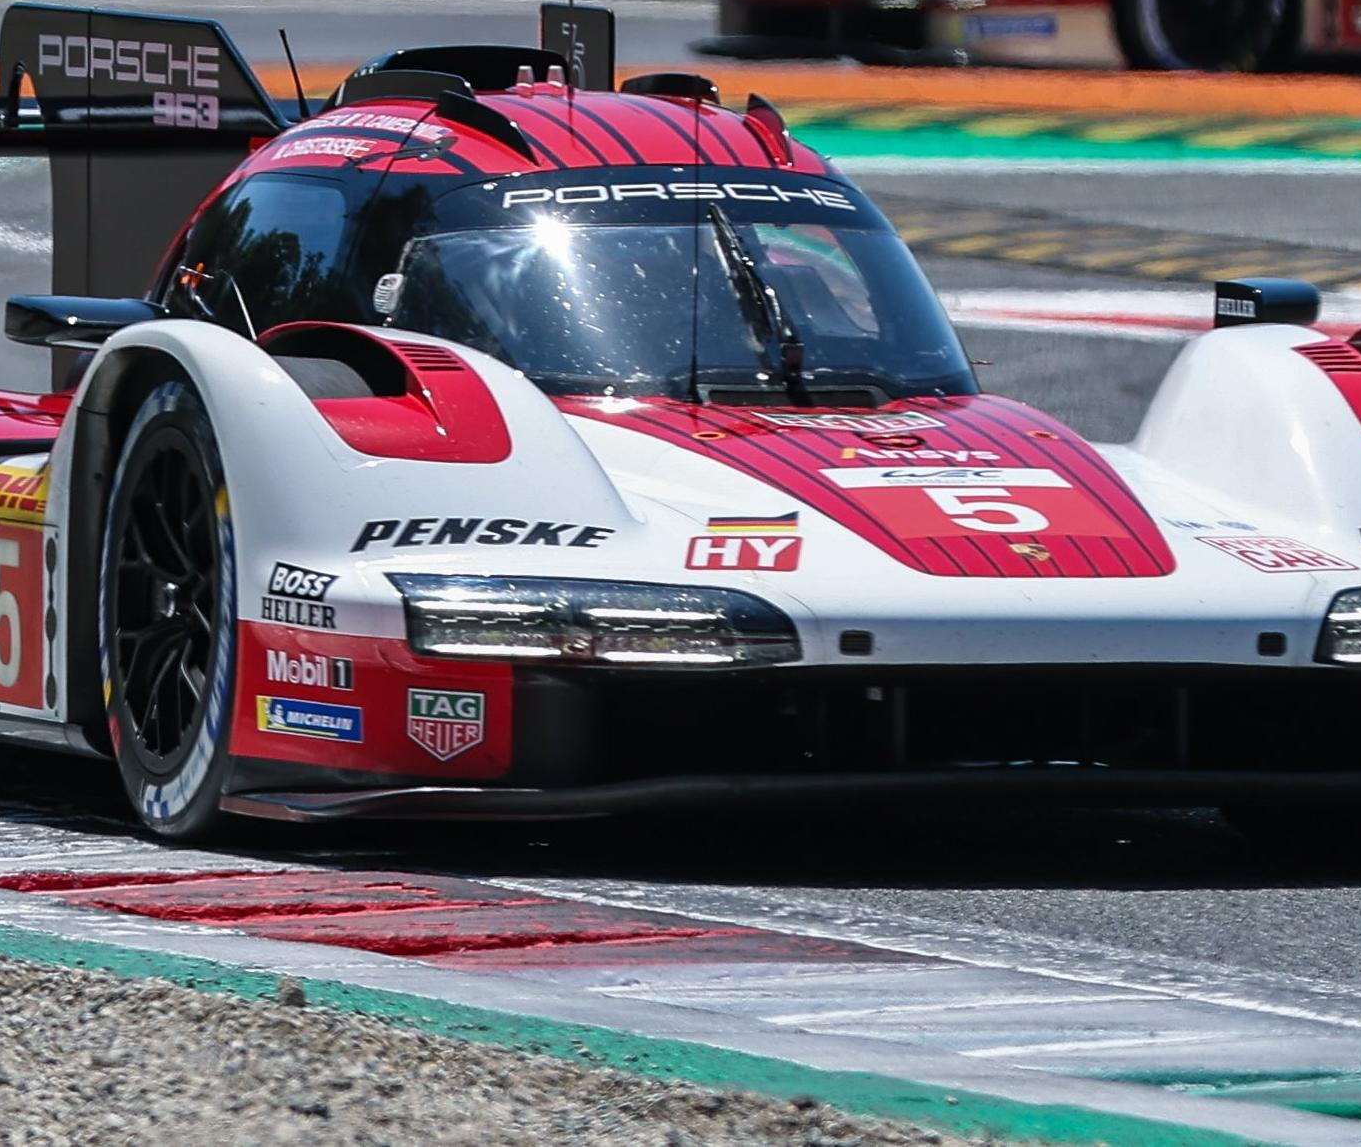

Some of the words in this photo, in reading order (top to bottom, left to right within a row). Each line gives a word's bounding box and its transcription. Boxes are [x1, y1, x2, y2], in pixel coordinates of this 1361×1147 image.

[38, 33, 220, 90] PORSCHE
[152, 91, 220, 131] 963
[501, 182, 857, 212] PORSCHE
[841, 447, 1002, 462] Ansys
[881, 469, 1004, 479] WEC
[922, 487, 1051, 534] 5
[349, 517, 617, 554] PENSKE
[1208, 538, 1306, 550] HYPER
[690, 538, 798, 568] HY
[1237, 549, 1347, 568] CAR
[270, 566, 332, 597] BOSS
[261, 596, 337, 630] HELLER
[266, 648, 329, 688] Mobil
[287, 711, 354, 731] MICHELIN
[413, 694, 478, 718] TAG
[411, 720, 479, 754] HEUER
